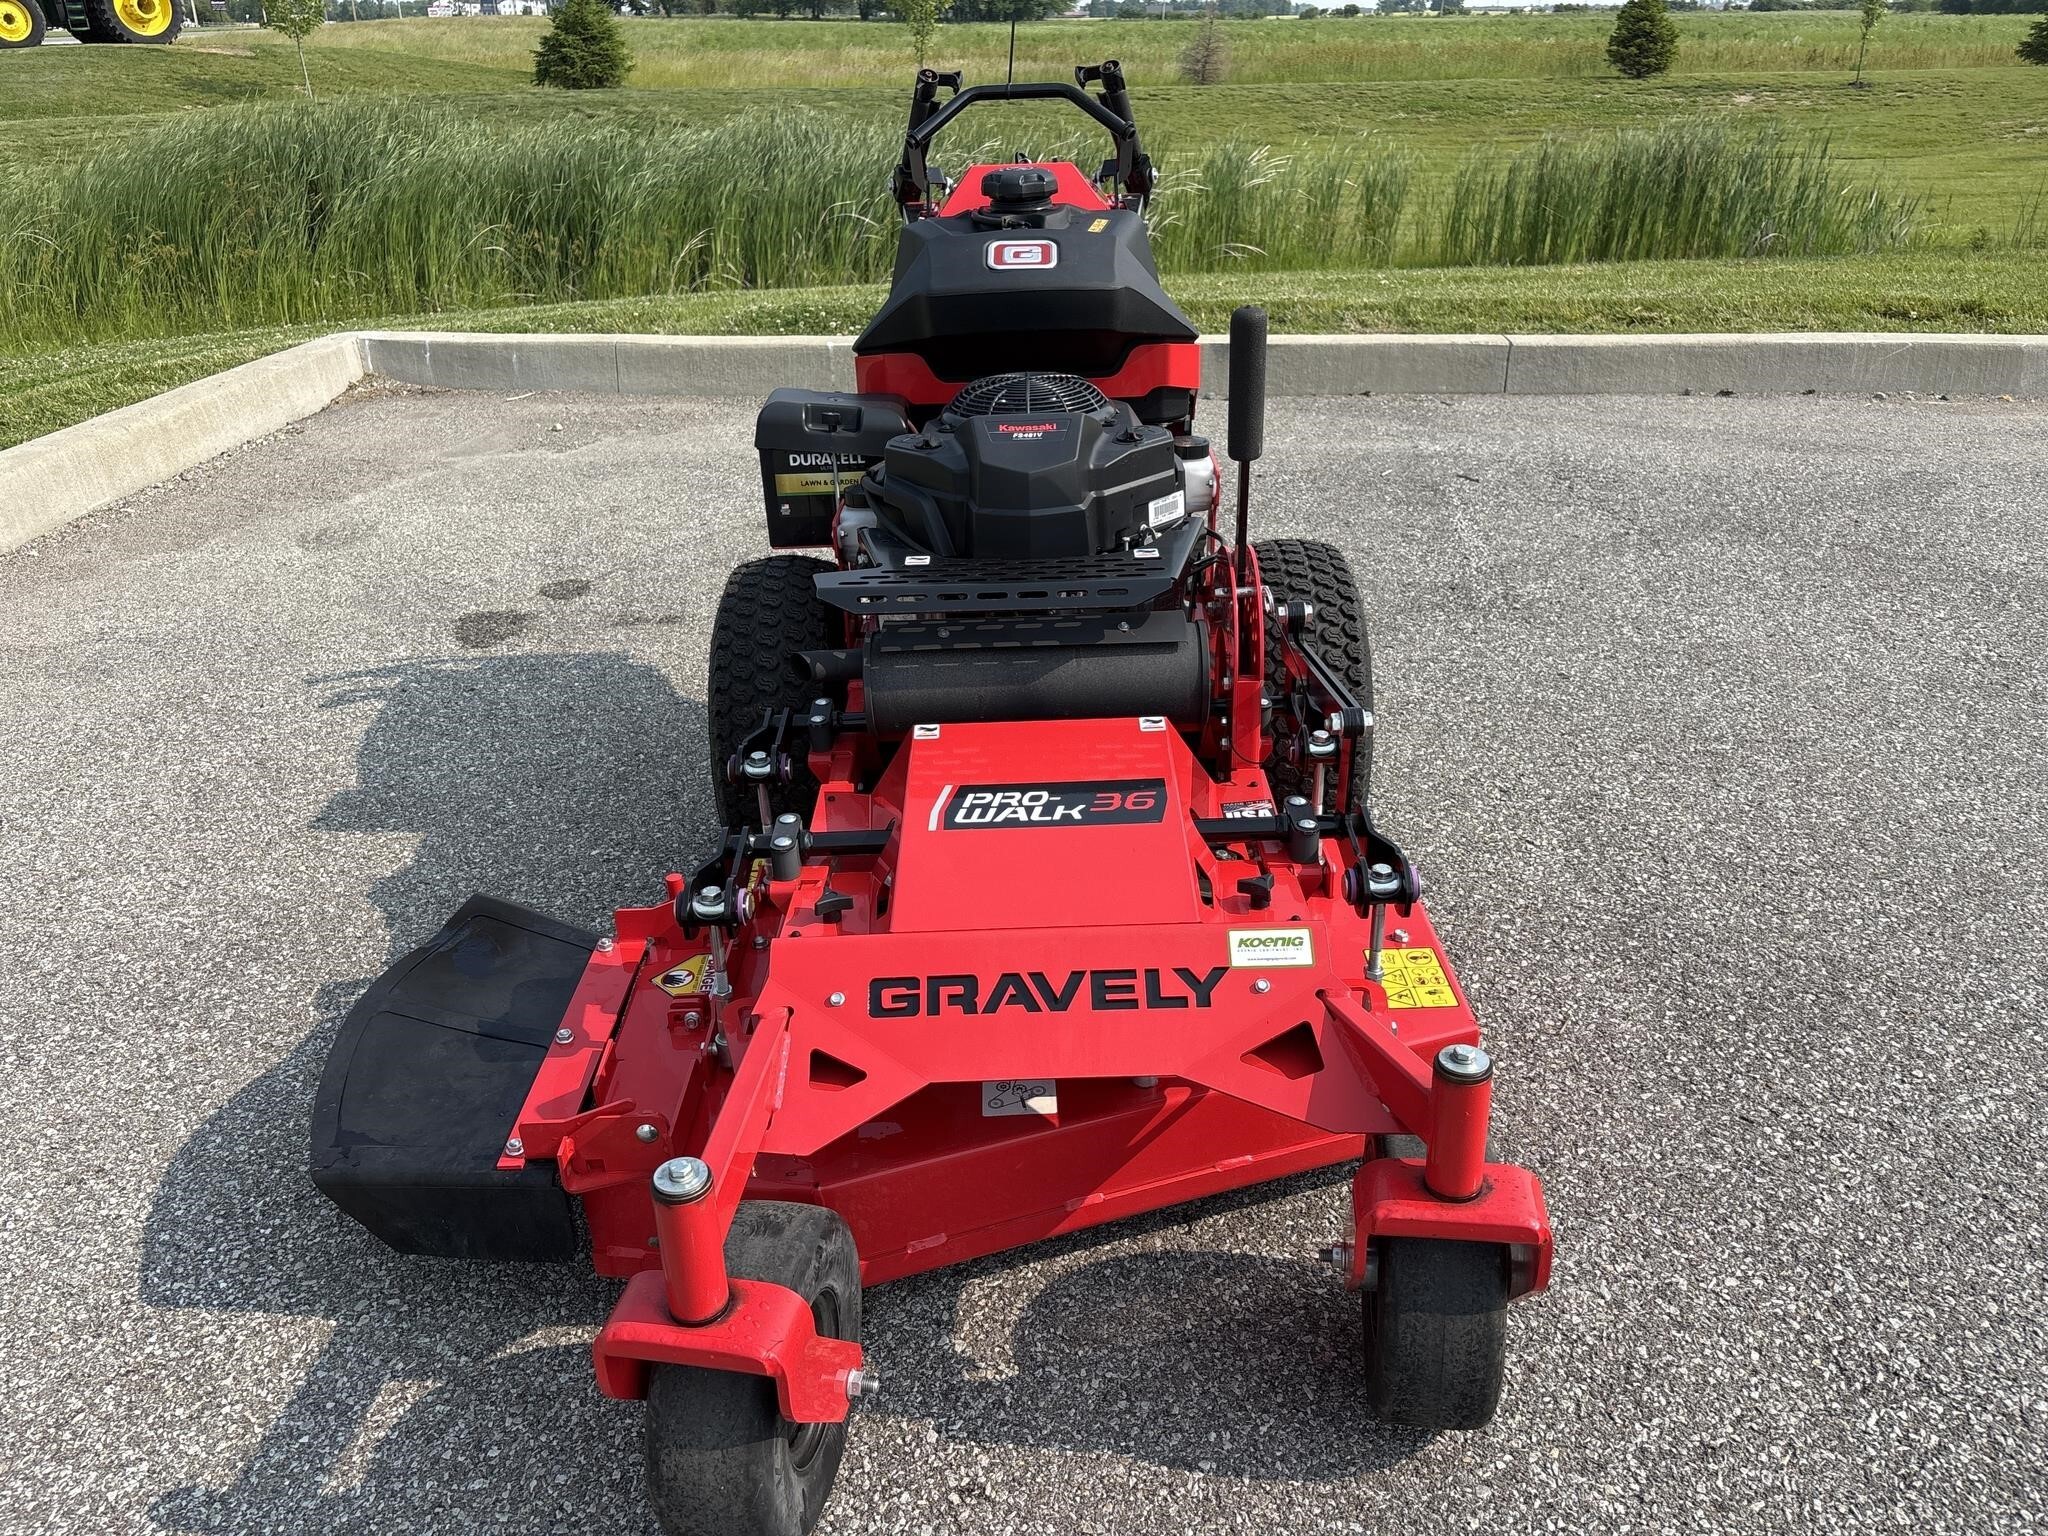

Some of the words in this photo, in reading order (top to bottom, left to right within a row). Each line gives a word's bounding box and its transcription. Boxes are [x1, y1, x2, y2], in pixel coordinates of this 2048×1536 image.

[999, 423, 1056, 432] Kawasaki
[830, 478, 859, 486] GRDEN
[962, 791, 1061, 807] PRO-
[954, 804, 1086, 823] WALK
[1090, 791, 1156, 811] 36
[1238, 937, 1304, 948] KOENIG
[868, 967, 1230, 1017] GRAVELY
